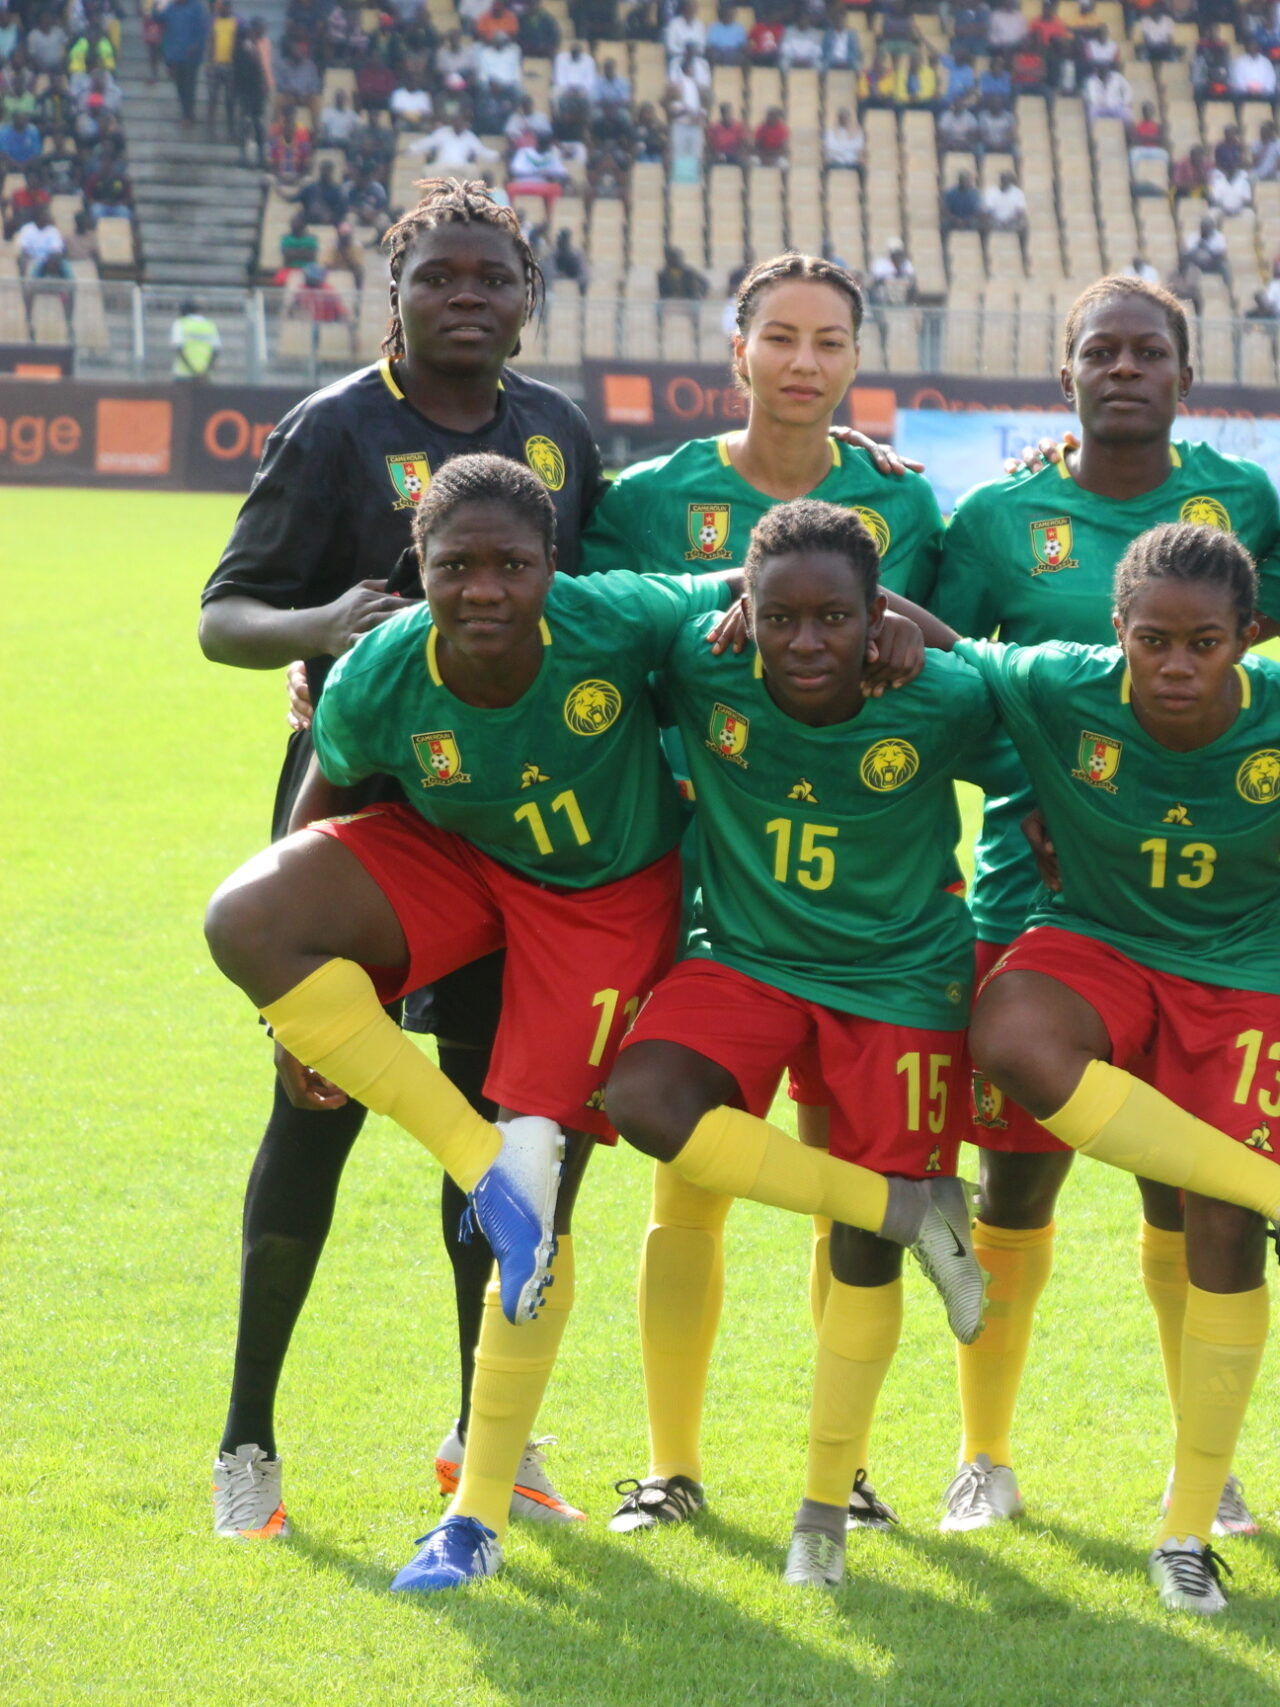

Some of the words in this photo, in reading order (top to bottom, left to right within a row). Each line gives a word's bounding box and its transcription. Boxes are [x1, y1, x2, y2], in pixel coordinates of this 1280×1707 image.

[513, 789, 592, 855] 11
[766, 817, 839, 891] 15
[1140, 837, 1217, 889] 13
[896, 1051, 952, 1134] 15
